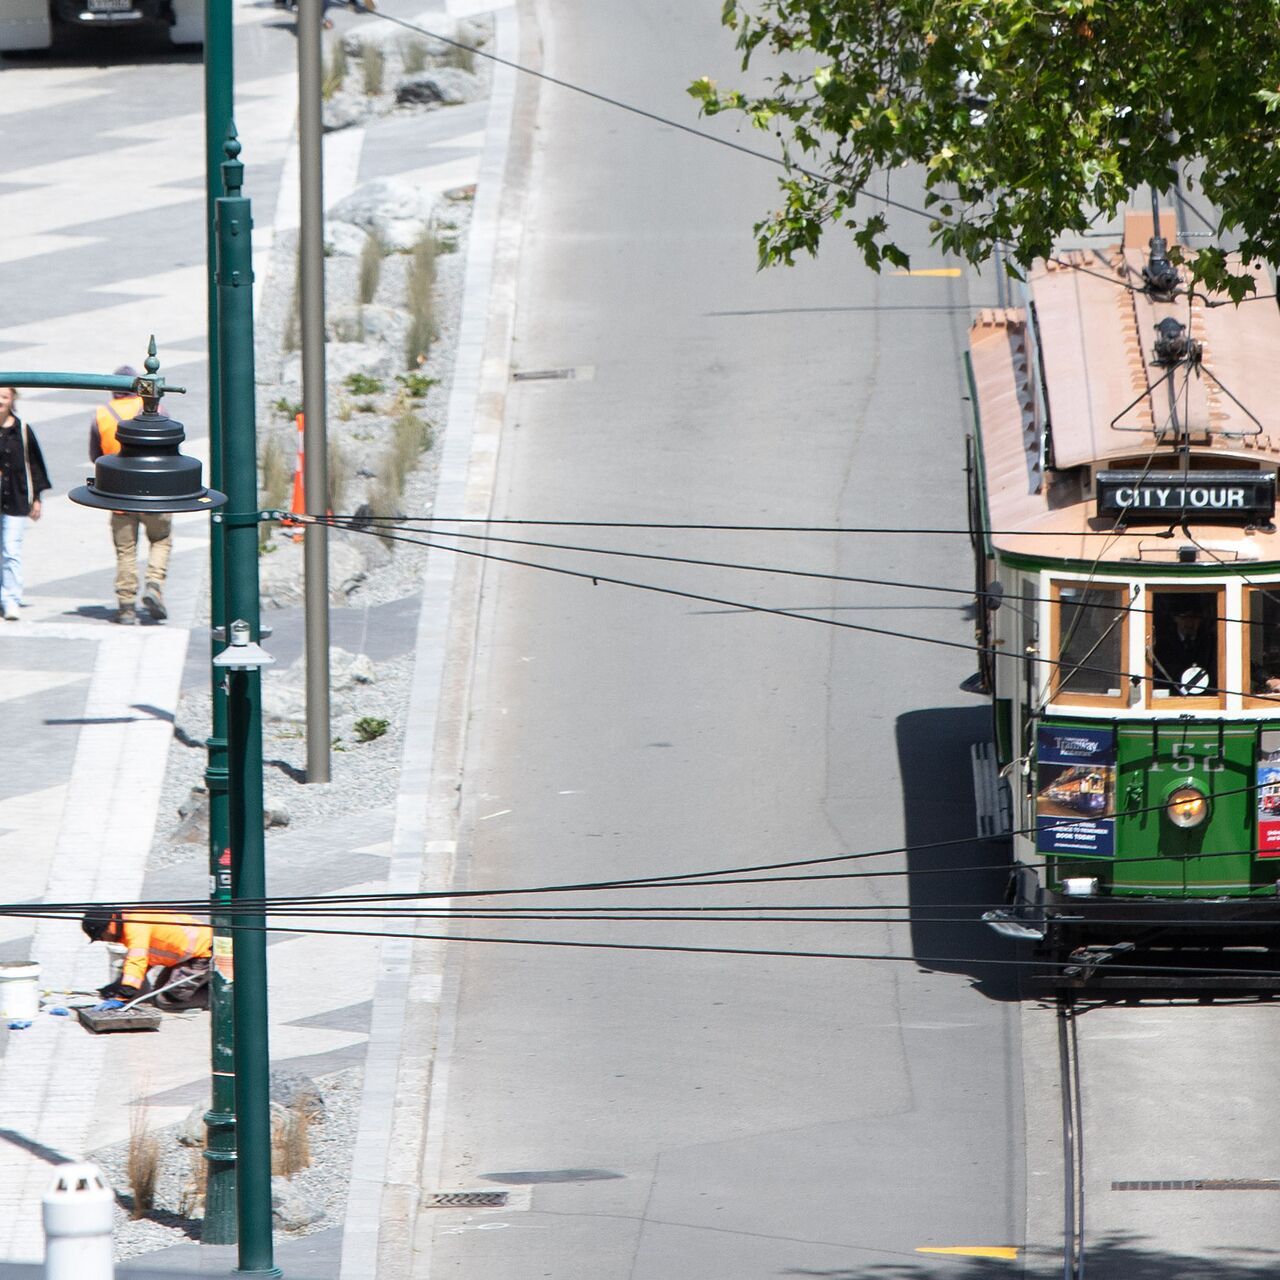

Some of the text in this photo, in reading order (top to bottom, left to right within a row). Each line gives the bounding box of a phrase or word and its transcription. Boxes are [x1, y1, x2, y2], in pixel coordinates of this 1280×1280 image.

[1115, 487, 1245, 507] CITY TOUR
[1147, 743, 1225, 772] 152
